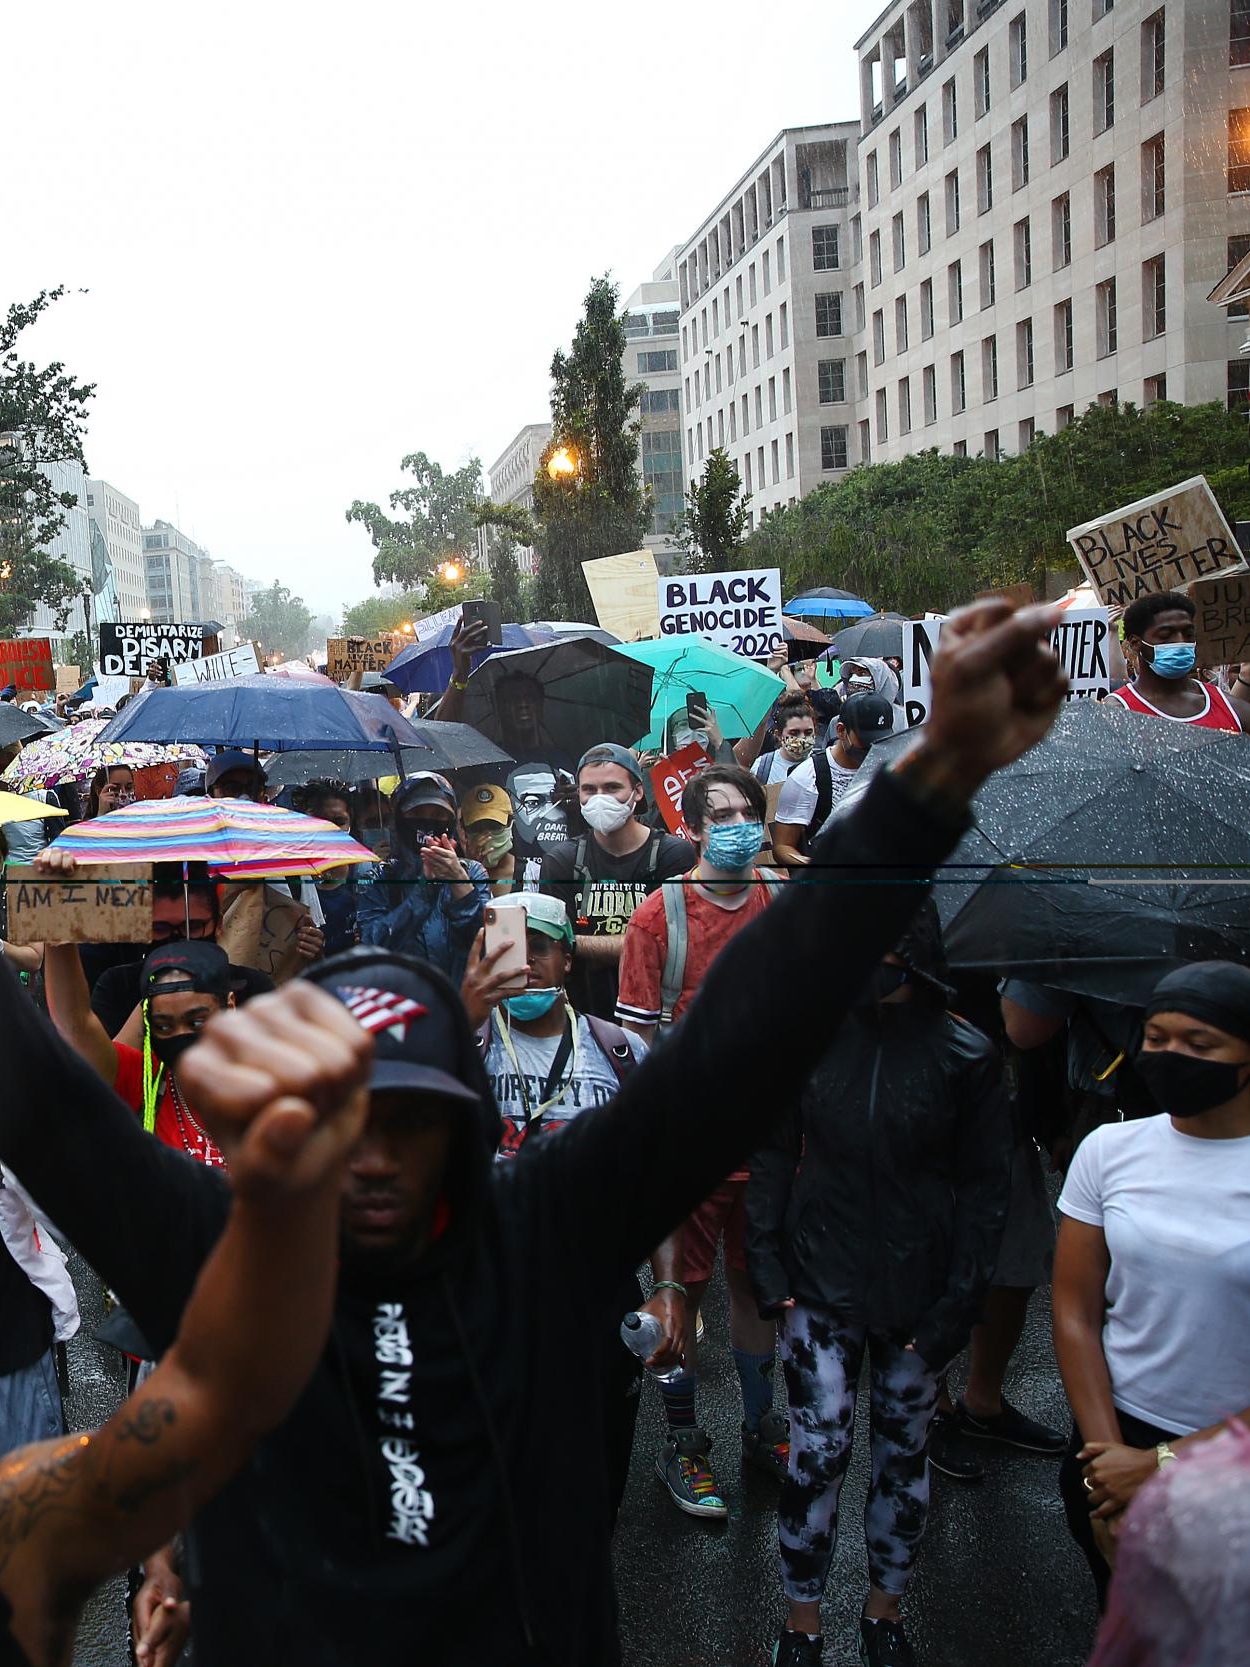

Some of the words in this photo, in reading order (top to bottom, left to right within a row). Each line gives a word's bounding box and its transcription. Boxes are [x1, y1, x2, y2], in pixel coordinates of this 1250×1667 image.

[1075, 507, 1182, 568] BLACK
[1092, 537, 1178, 588] LIVES
[1106, 538, 1243, 607] MATTER
[666, 576, 771, 608] BLACK
[115, 625, 203, 638] DEMILITARIZE
[660, 606, 777, 635] GENOCIDE
[122, 637, 203, 658] DISARM
[334, 658, 387, 671] MATTER
[16, 884, 52, 914] AM
[60, 884, 87, 905] I
[95, 886, 150, 908] NEXT
[589, 883, 632, 892] NIVERSITY
[635, 883, 647, 892] OF
